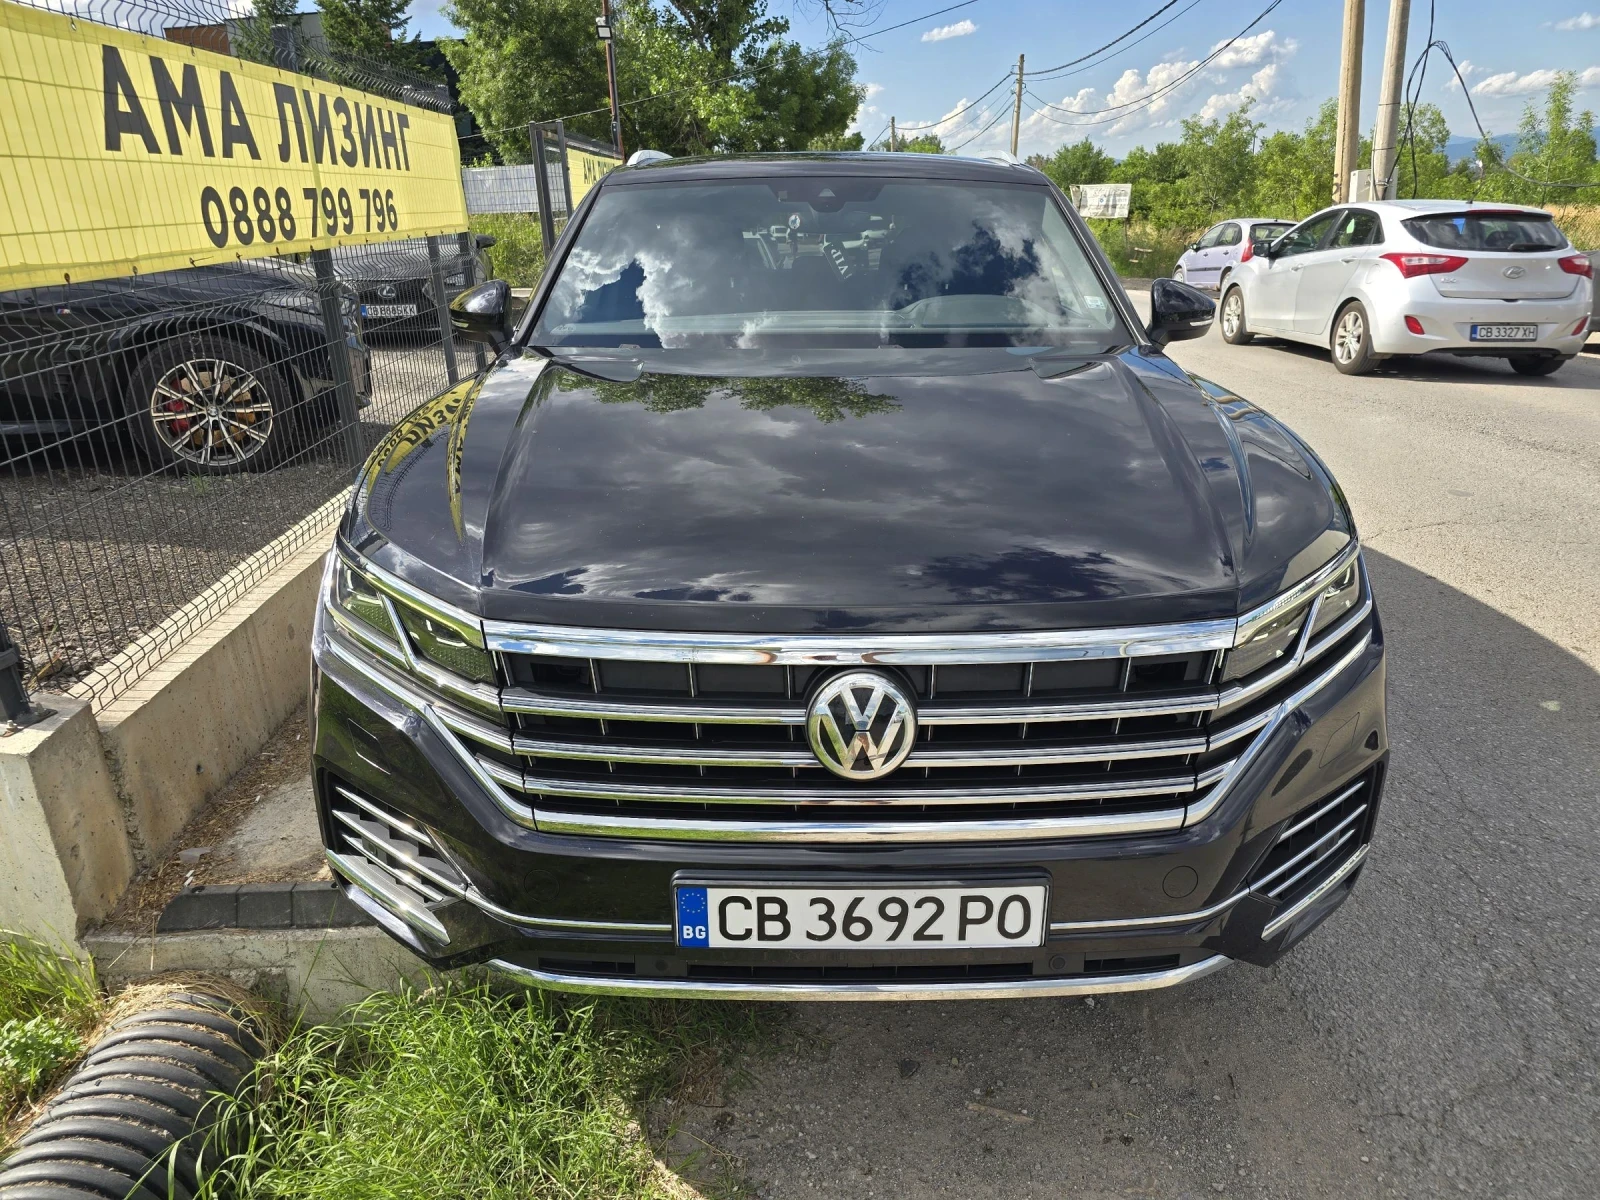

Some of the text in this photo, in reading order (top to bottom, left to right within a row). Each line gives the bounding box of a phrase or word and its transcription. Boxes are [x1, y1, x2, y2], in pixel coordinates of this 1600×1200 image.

[102, 44, 410, 171] АМА ЛИЗИНГ
[200, 186, 398, 248] 0888 799 796
[831, 249, 848, 274] VIP
[1479, 327, 1536, 338] CB 3327 XH
[683, 894, 1032, 942] BG CB 3692 PO
